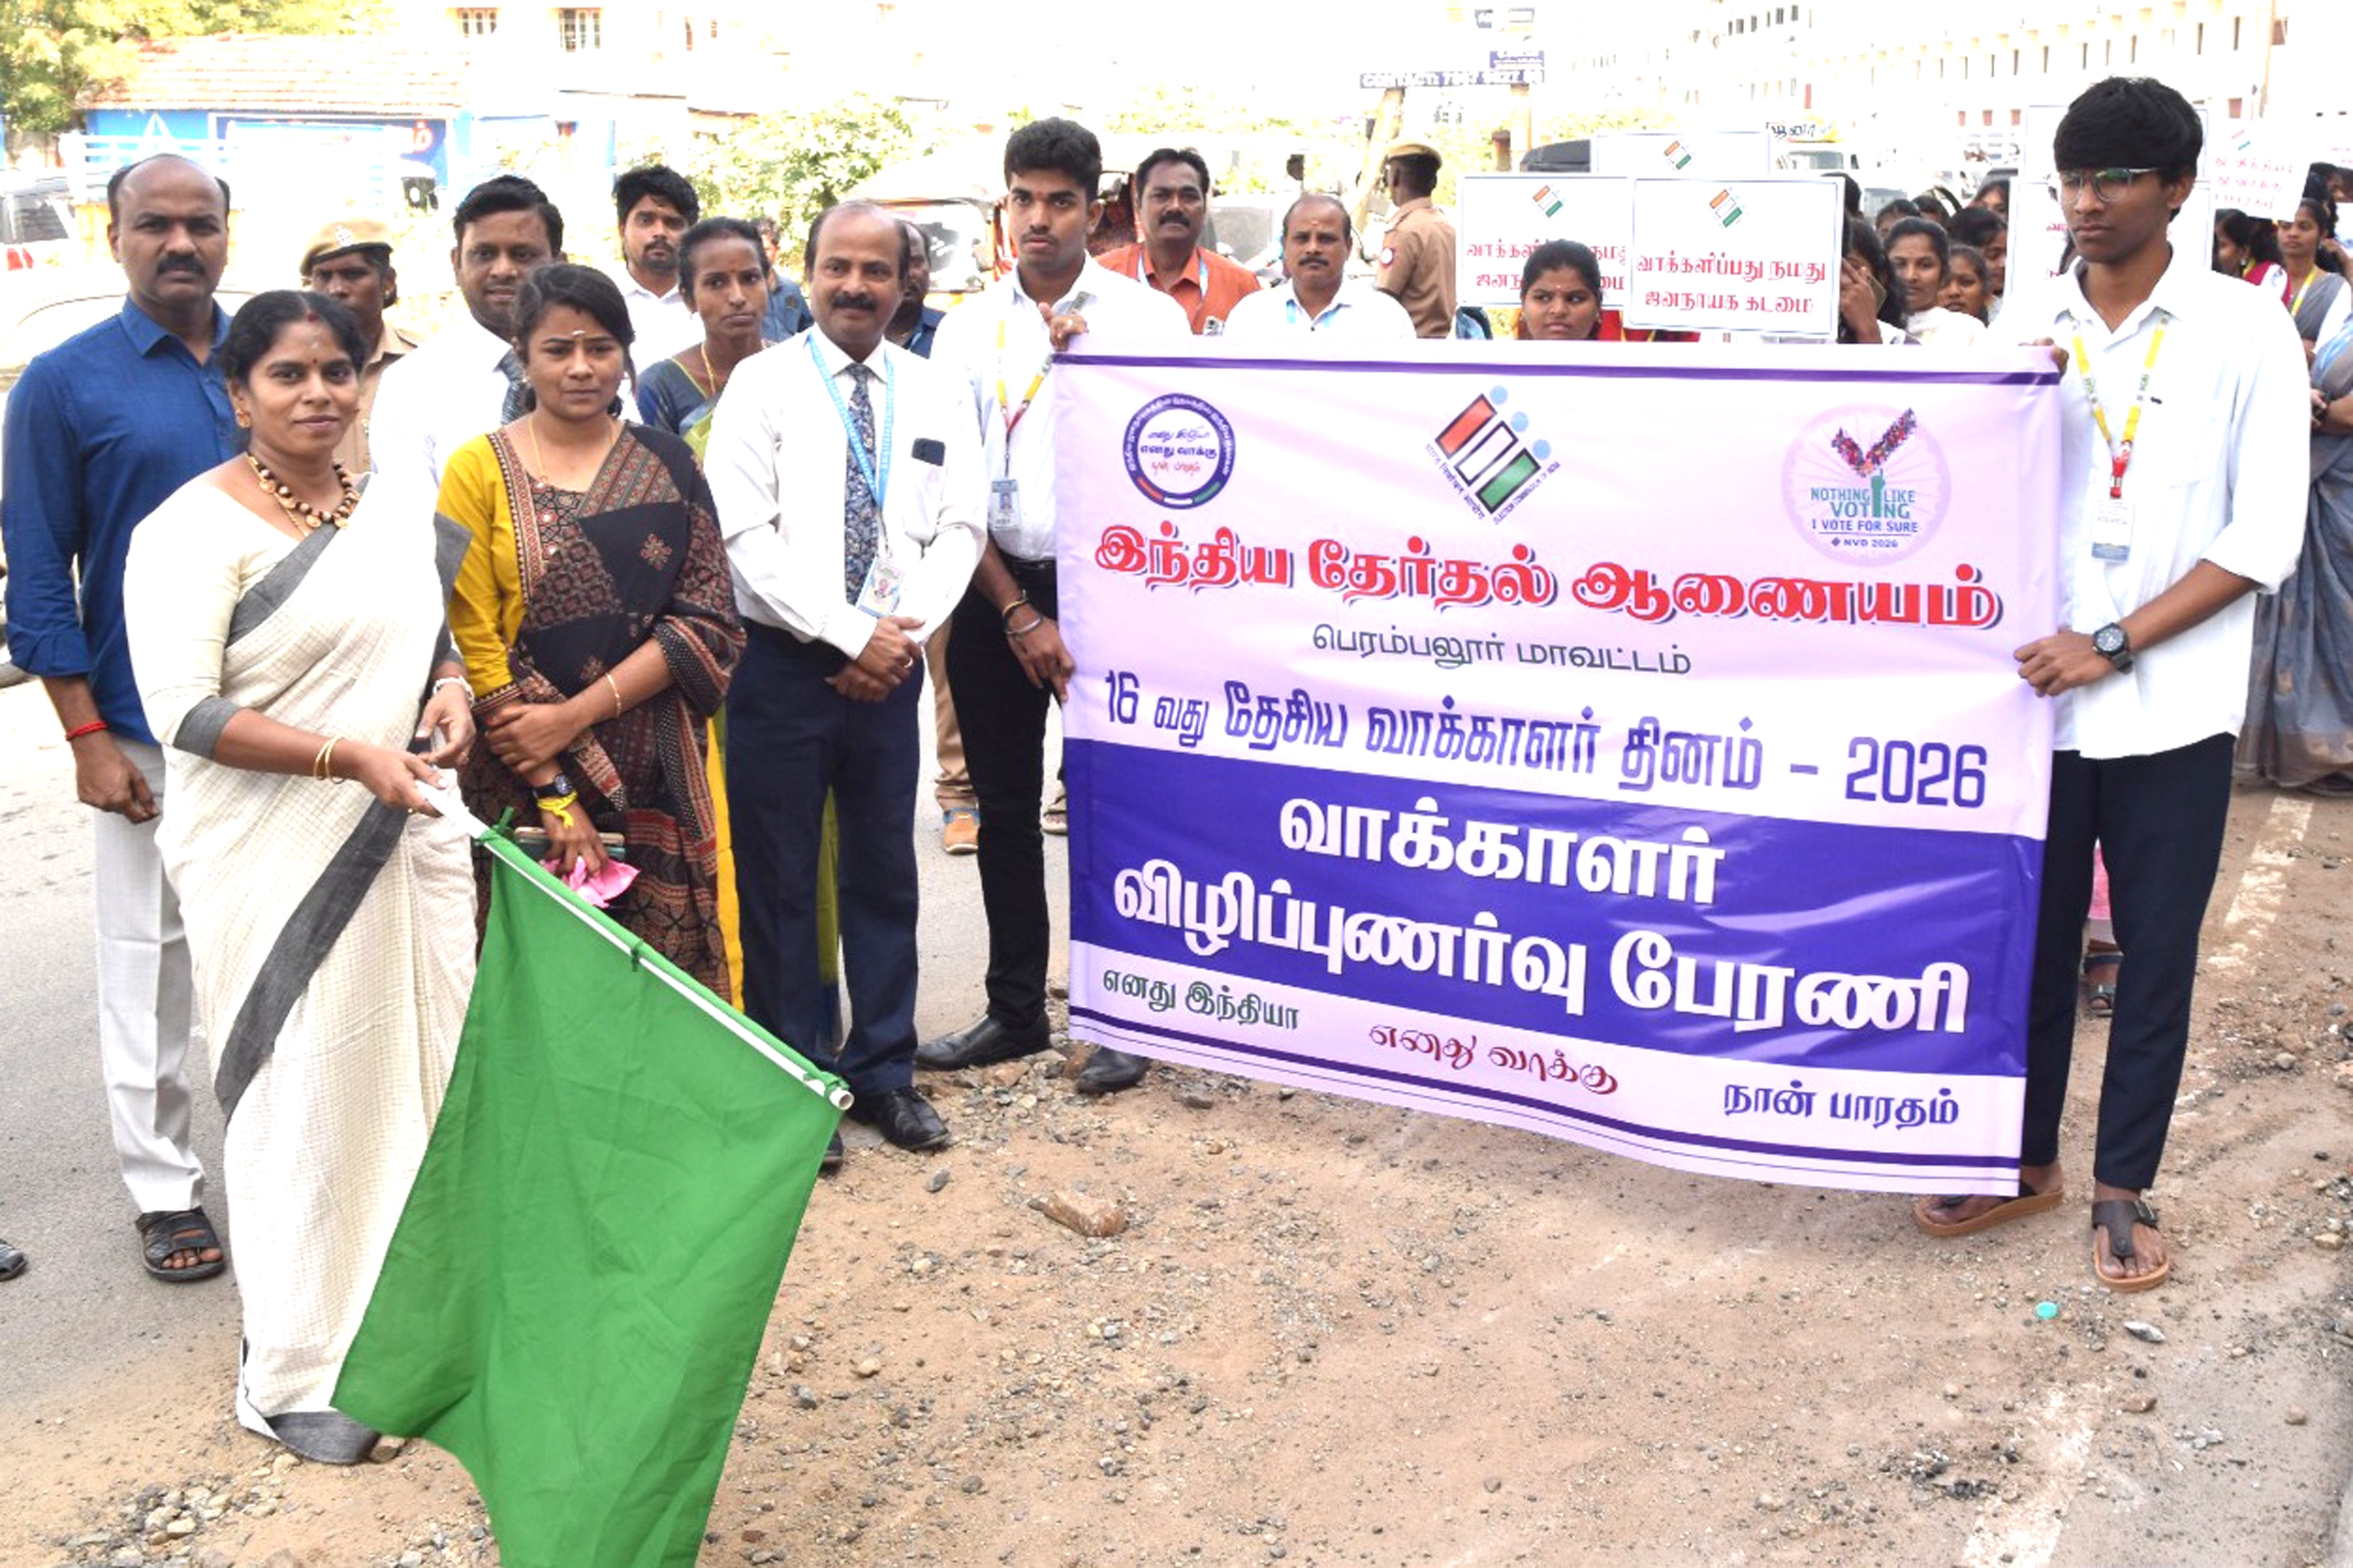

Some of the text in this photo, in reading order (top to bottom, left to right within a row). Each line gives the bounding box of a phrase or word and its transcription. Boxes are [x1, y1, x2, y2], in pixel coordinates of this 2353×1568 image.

[1637, 249, 1764, 283] வாக்களிப்பது
[1768, 260, 1825, 284] நமது
[1645, 291, 1814, 313] ஜனநாயக கடமை
[1811, 487, 1916, 503] NOTHING LIKE
[1812, 519, 1918, 533] I VOTE FOR SURE
[1843, 539, 1899, 548] NVD 2026
[1094, 520, 2003, 629] இந்திய தேர்தல் ஆணையம்
[1312, 623, 1691, 675] பெரம்பலூர் மாவட்டம்
[1105, 670, 1139, 725] 16
[1154, 694, 1209, 748] வது
[1224, 680, 1348, 751] தேசிய
[1365, 695, 1601, 774] வாக்காளர்
[1618, 716, 1764, 792] தினம்
[1845, 736, 1988, 808] 2026
[1279, 796, 1725, 905] வாக்காளர்
[1114, 858, 1970, 1033] விழிப்புணர்வு பேரணி
[1102, 968, 1299, 1029] எனது இந்தியா
[1369, 1024, 1619, 1095] எனது வாக்கு
[1723, 1079, 1961, 1130] நான் பாரதம்
